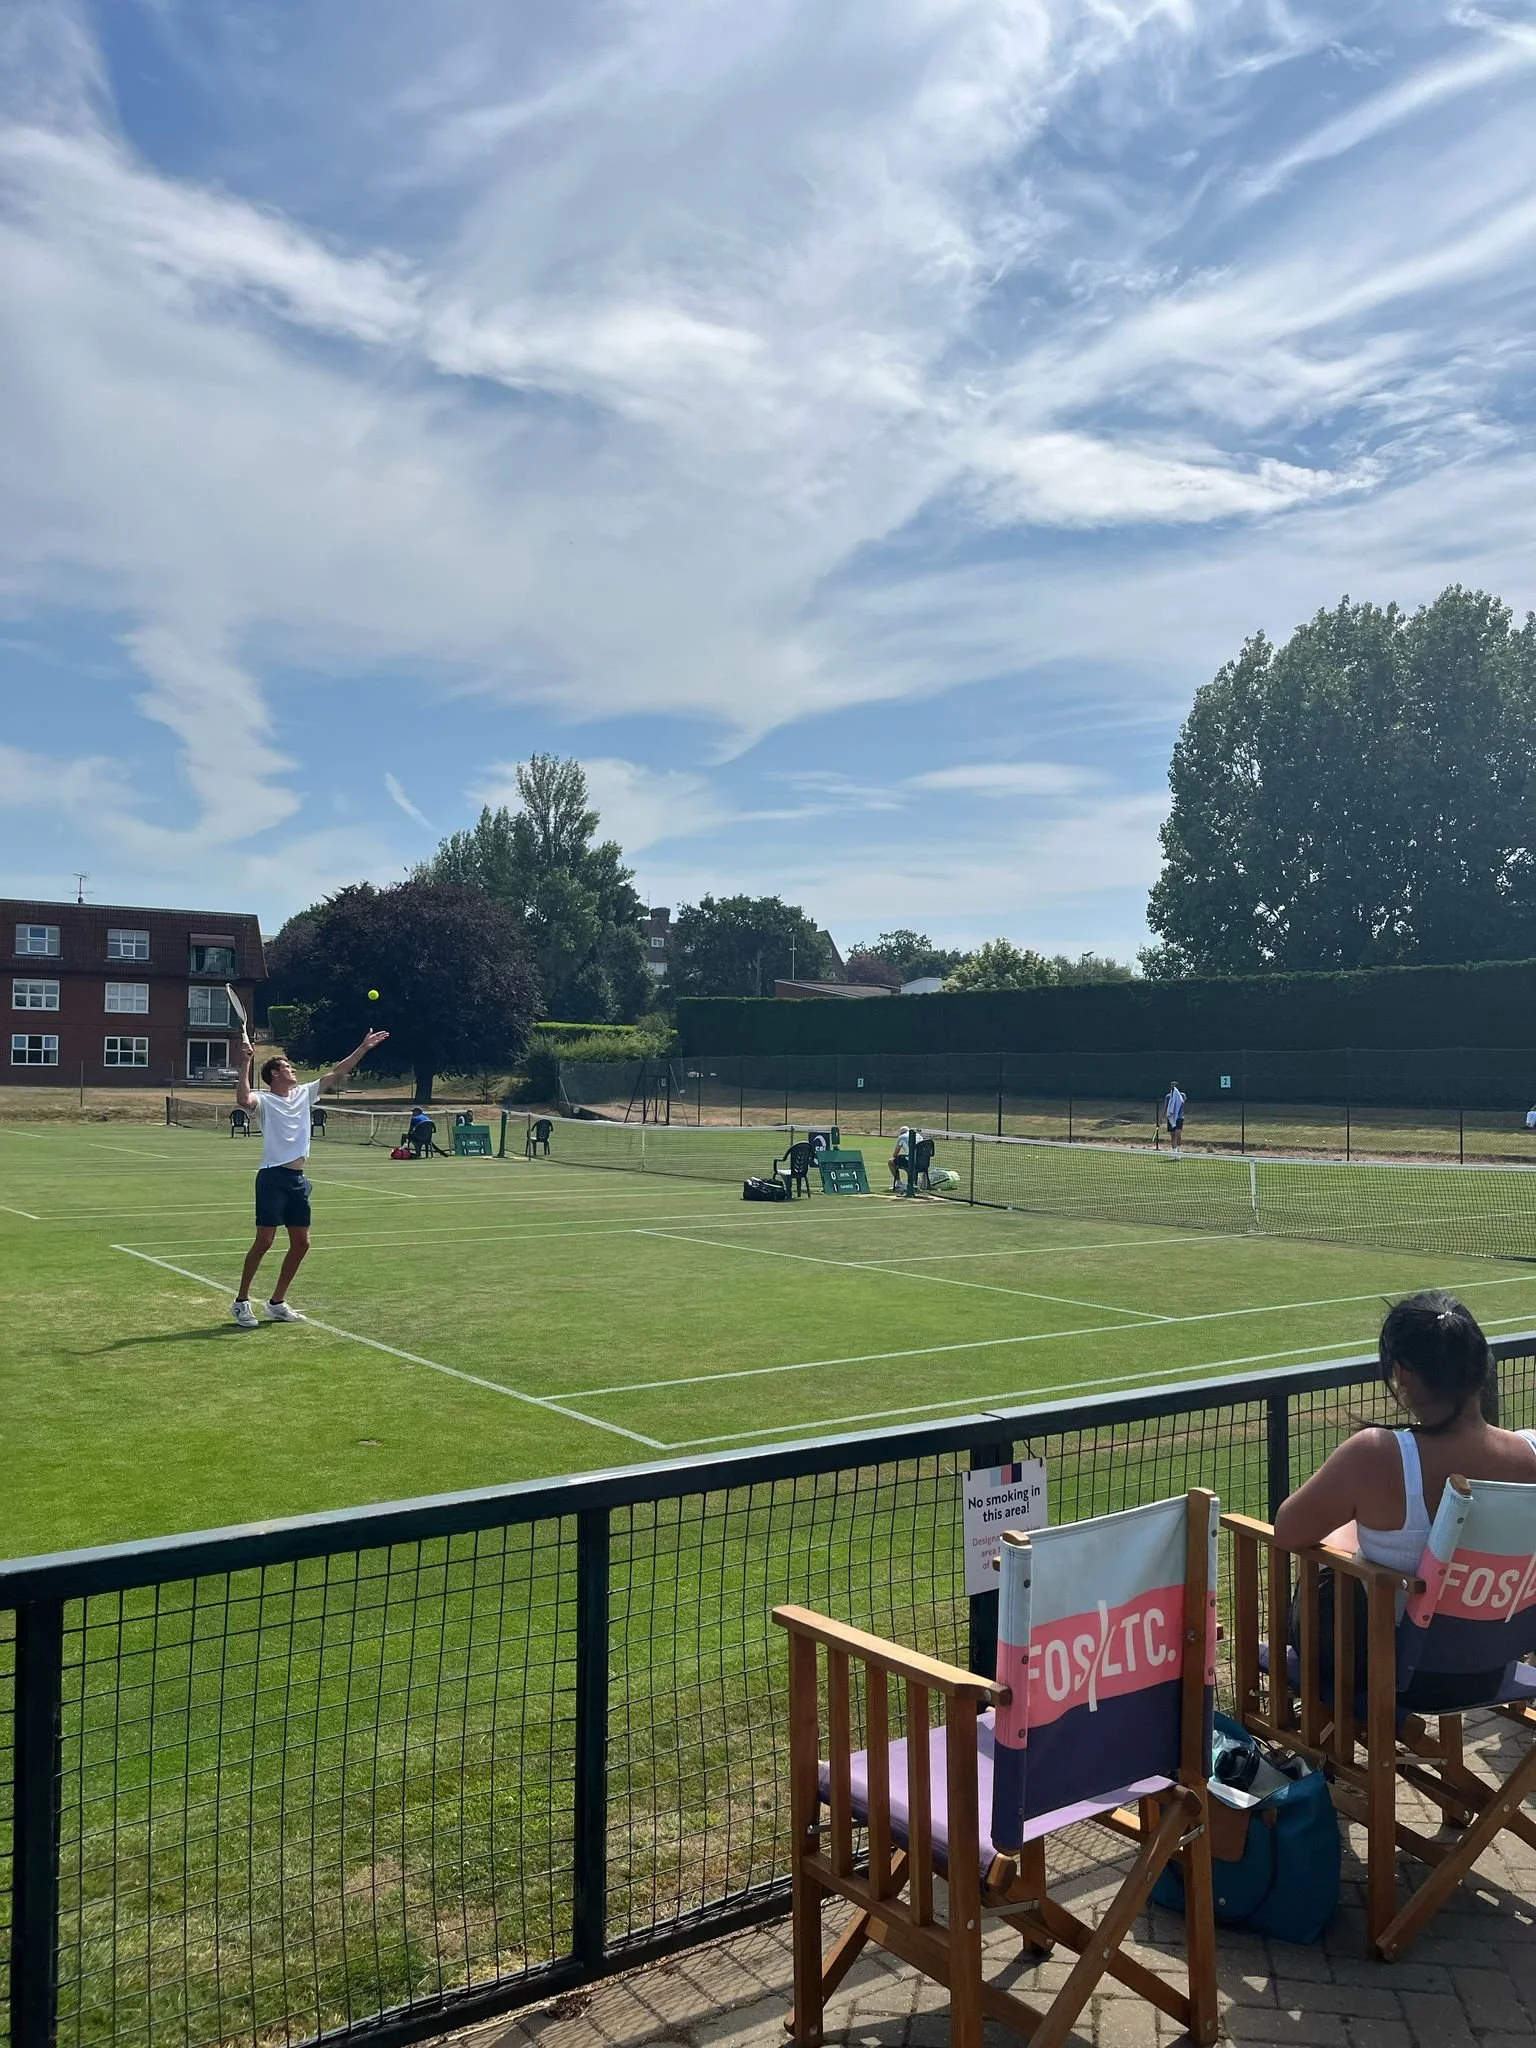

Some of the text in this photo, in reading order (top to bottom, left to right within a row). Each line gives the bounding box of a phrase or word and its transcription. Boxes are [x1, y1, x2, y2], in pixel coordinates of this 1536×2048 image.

[830, 1171, 837, 1180] 0
[852, 1170, 858, 1180] 1
[968, 1485, 1041, 1510] No smoking in
[983, 1501, 1030, 1522] this area!
[981, 1548, 997, 1558] area
[983, 1559, 990, 1570] of
